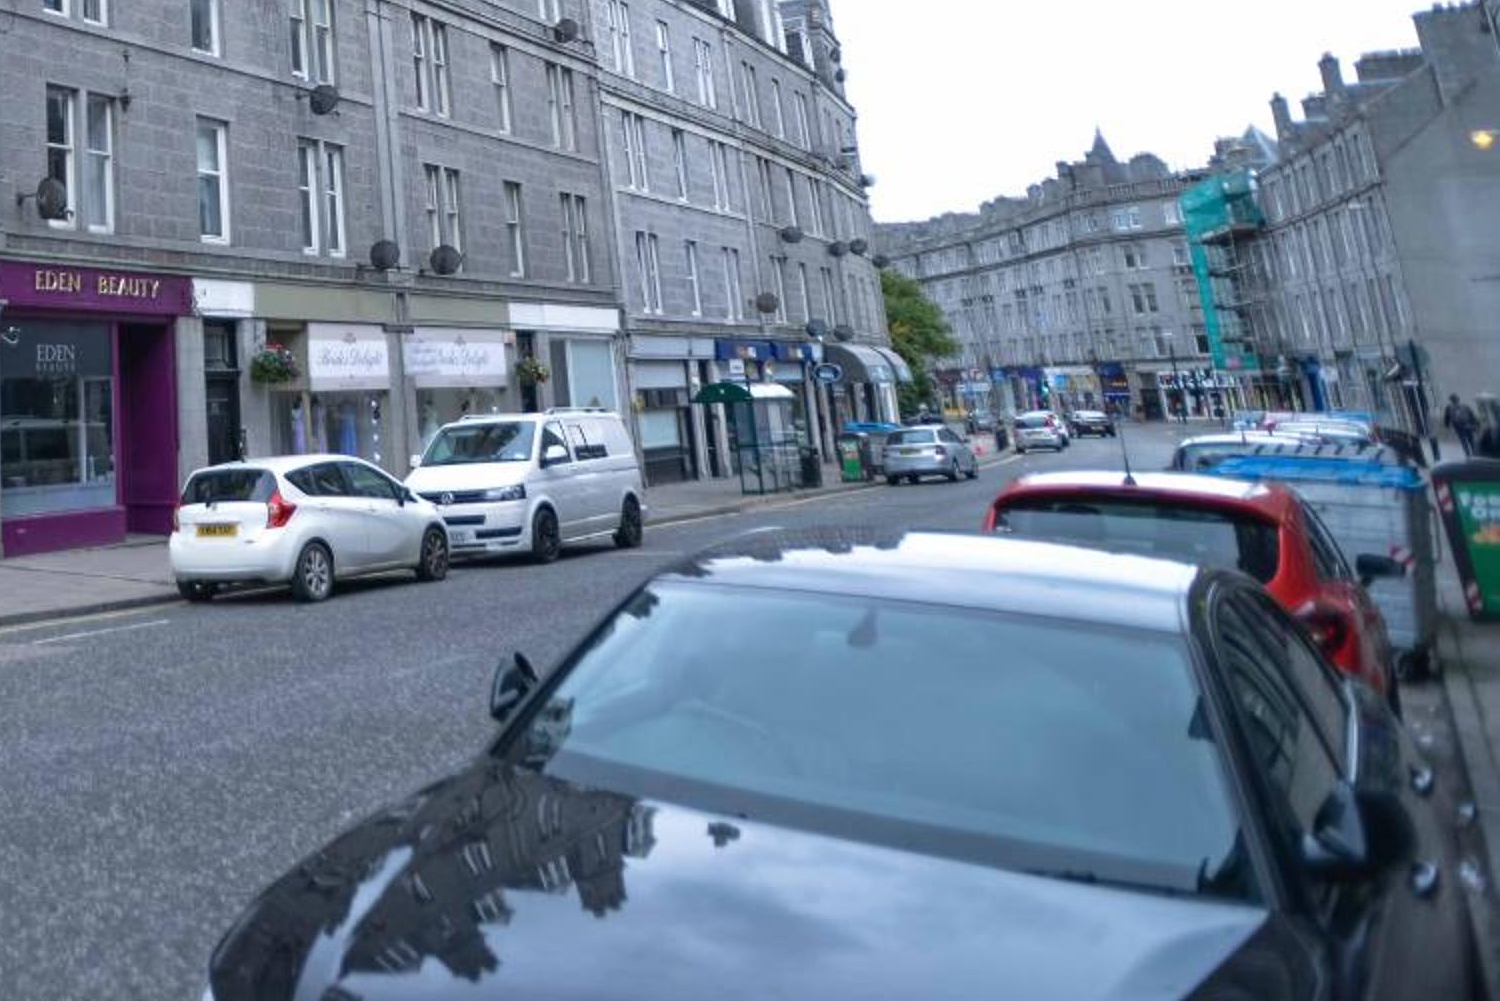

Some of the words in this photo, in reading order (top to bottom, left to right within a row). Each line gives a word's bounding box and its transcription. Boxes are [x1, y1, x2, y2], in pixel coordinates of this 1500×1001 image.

[35, 270, 81, 292] EDEN
[98, 275, 160, 298] BEAUTY
[36, 344, 76, 362] EDEN
